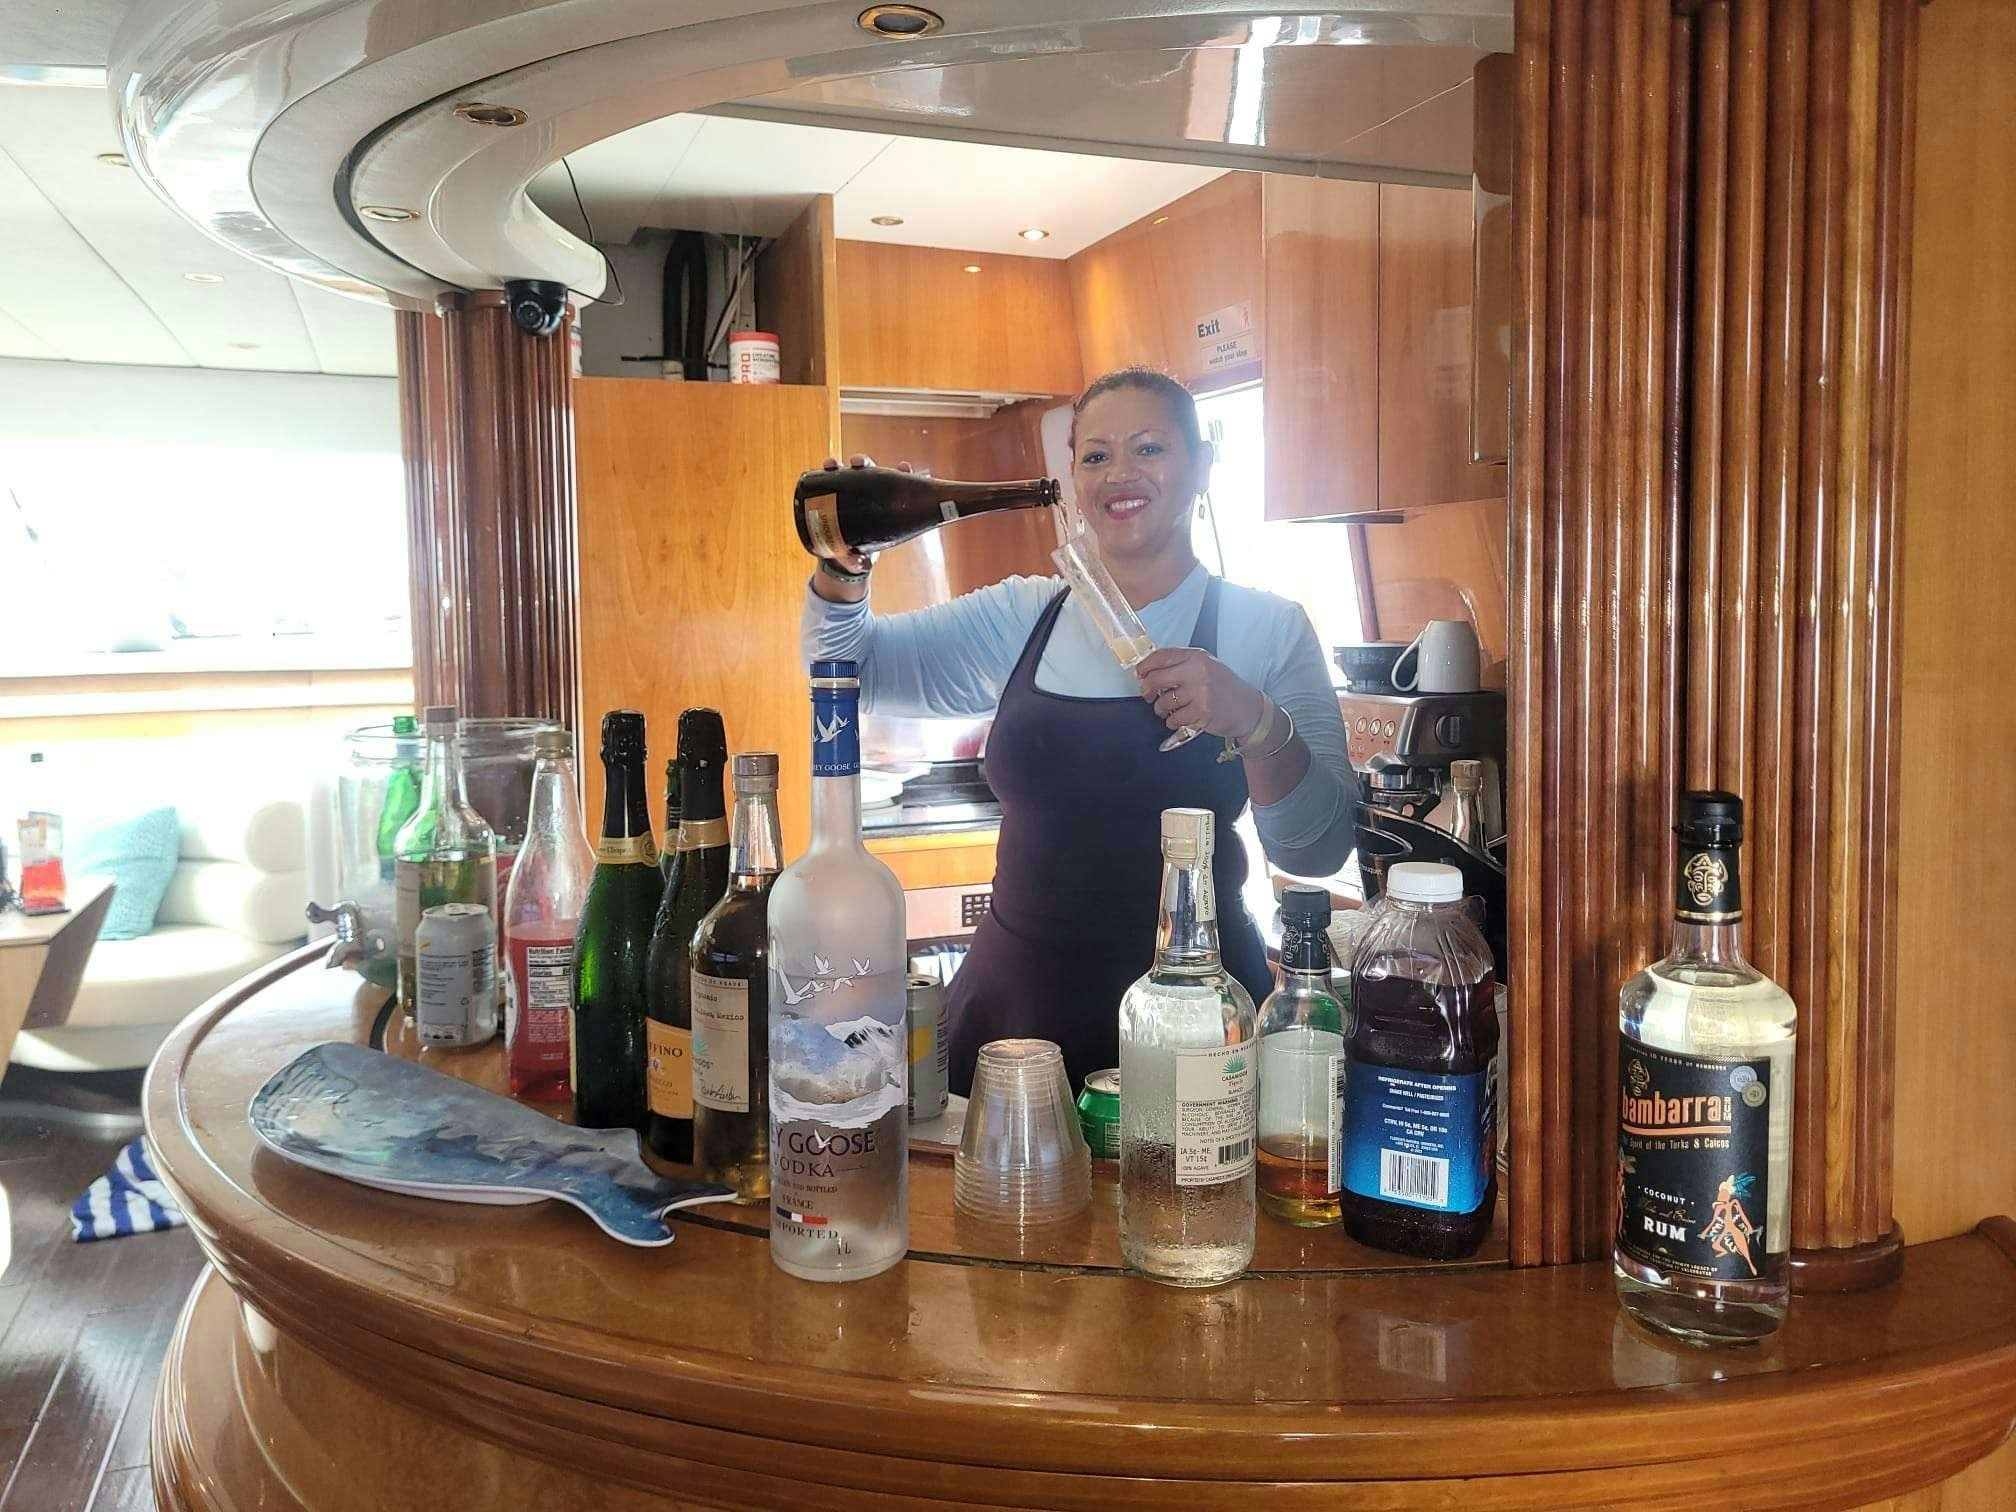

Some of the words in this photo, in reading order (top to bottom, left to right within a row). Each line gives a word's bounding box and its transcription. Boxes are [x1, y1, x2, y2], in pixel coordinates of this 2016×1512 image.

[1197, 319, 1220, 338] Exit
[824, 763, 851, 771] GOOSE
[1622, 1086, 1721, 1125] bambarra
[1723, 1096, 1732, 1121] RUM
[788, 1130, 876, 1157] GOOSE
[1655, 1139, 1666, 1150] the
[1670, 1139, 1689, 1149] Turks
[1694, 1138, 1700, 1148] &
[1704, 1137, 1730, 1149] Caicos
[773, 1151, 835, 1178] VODKA
[1186, 1155, 1195, 1163] VT
[1644, 1186, 1686, 1206] COCONUT
[1643, 1215, 1688, 1243] RUM
